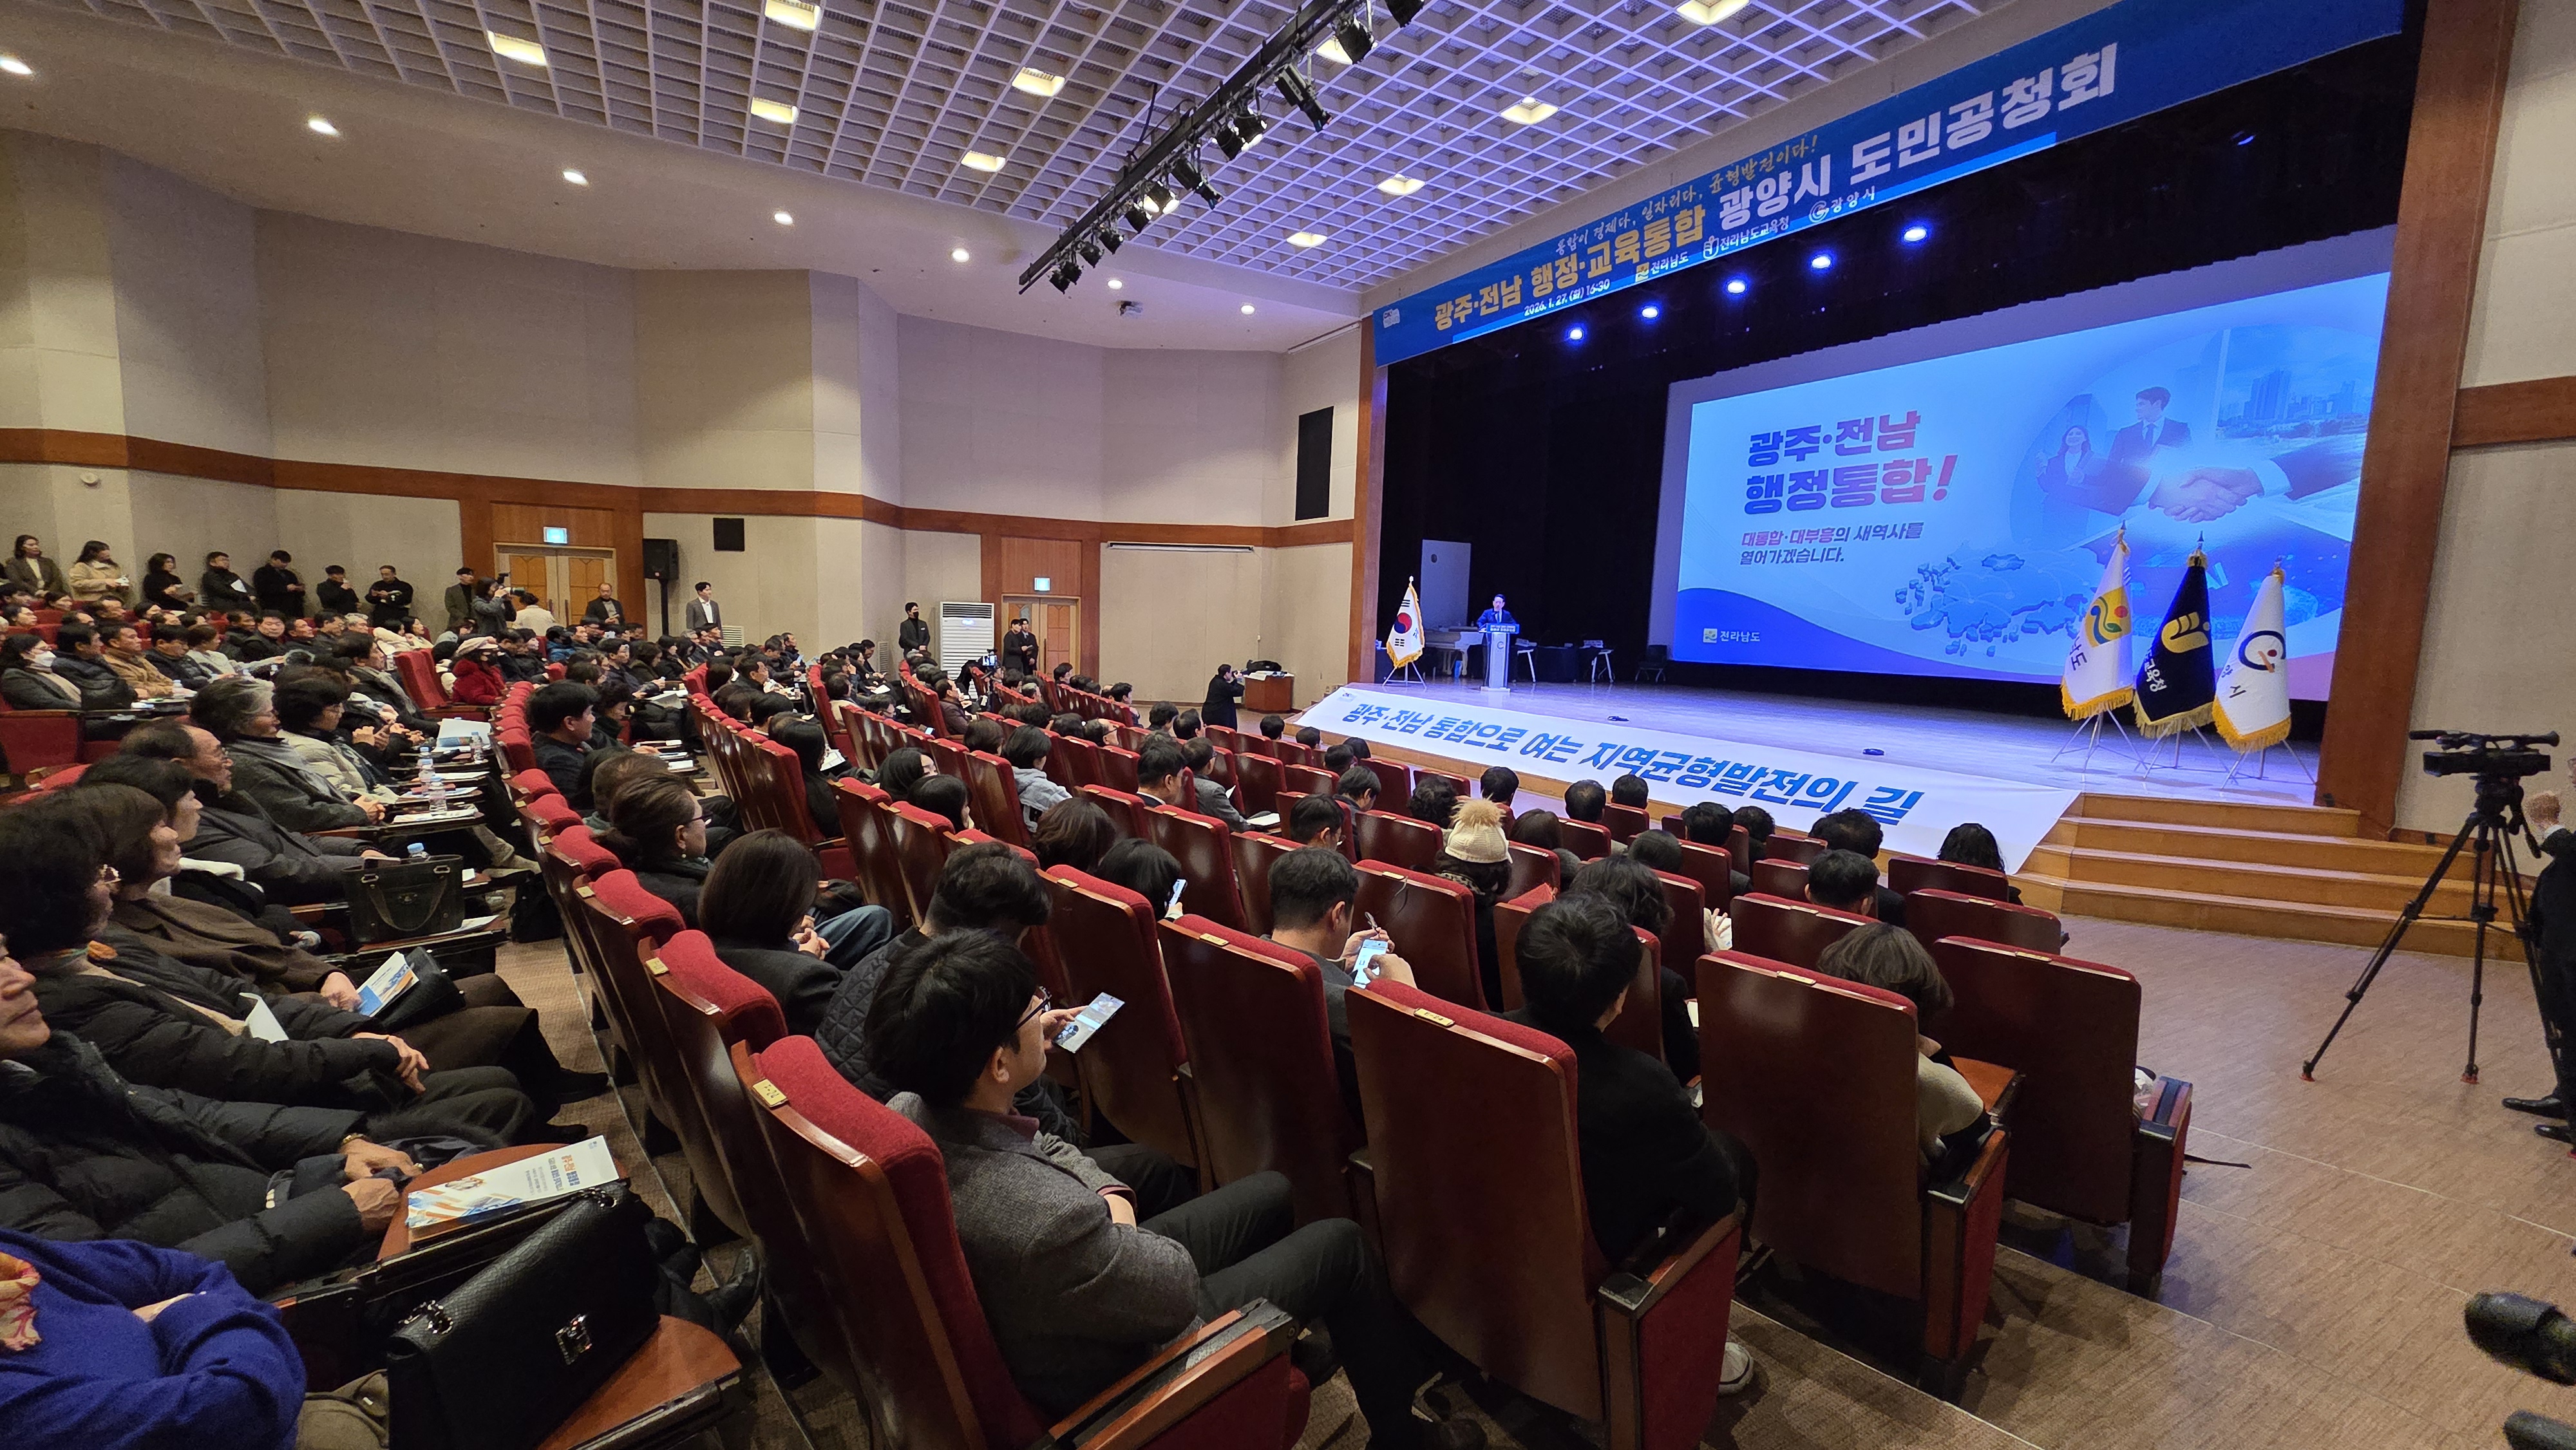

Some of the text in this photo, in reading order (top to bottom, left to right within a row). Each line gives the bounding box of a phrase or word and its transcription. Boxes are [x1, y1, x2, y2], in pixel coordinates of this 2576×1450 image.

[1434, 42, 2118, 331] 광주·전남 행정·교육통합 광양시 도민공청회
[1642, 184, 1703, 221] 일자리다,
[1709, 134, 1818, 194] 균형발전이다!
[1720, 215, 1790, 252] 전라남도교육청
[1650, 251, 1689, 275] 전라남도
[1586, 278, 1611, 296] 16:30
[1747, 409, 1922, 467] 광주·전남
[1743, 454, 1959, 516] 행정통합!
[1741, 522, 1924, 547] 대통합·대부흥의 새역사를
[1719, 630, 1761, 643] 전라남도
[1341, 703, 1926, 826] 광주·전남 통합으로 여는 지역균형발전의 길
